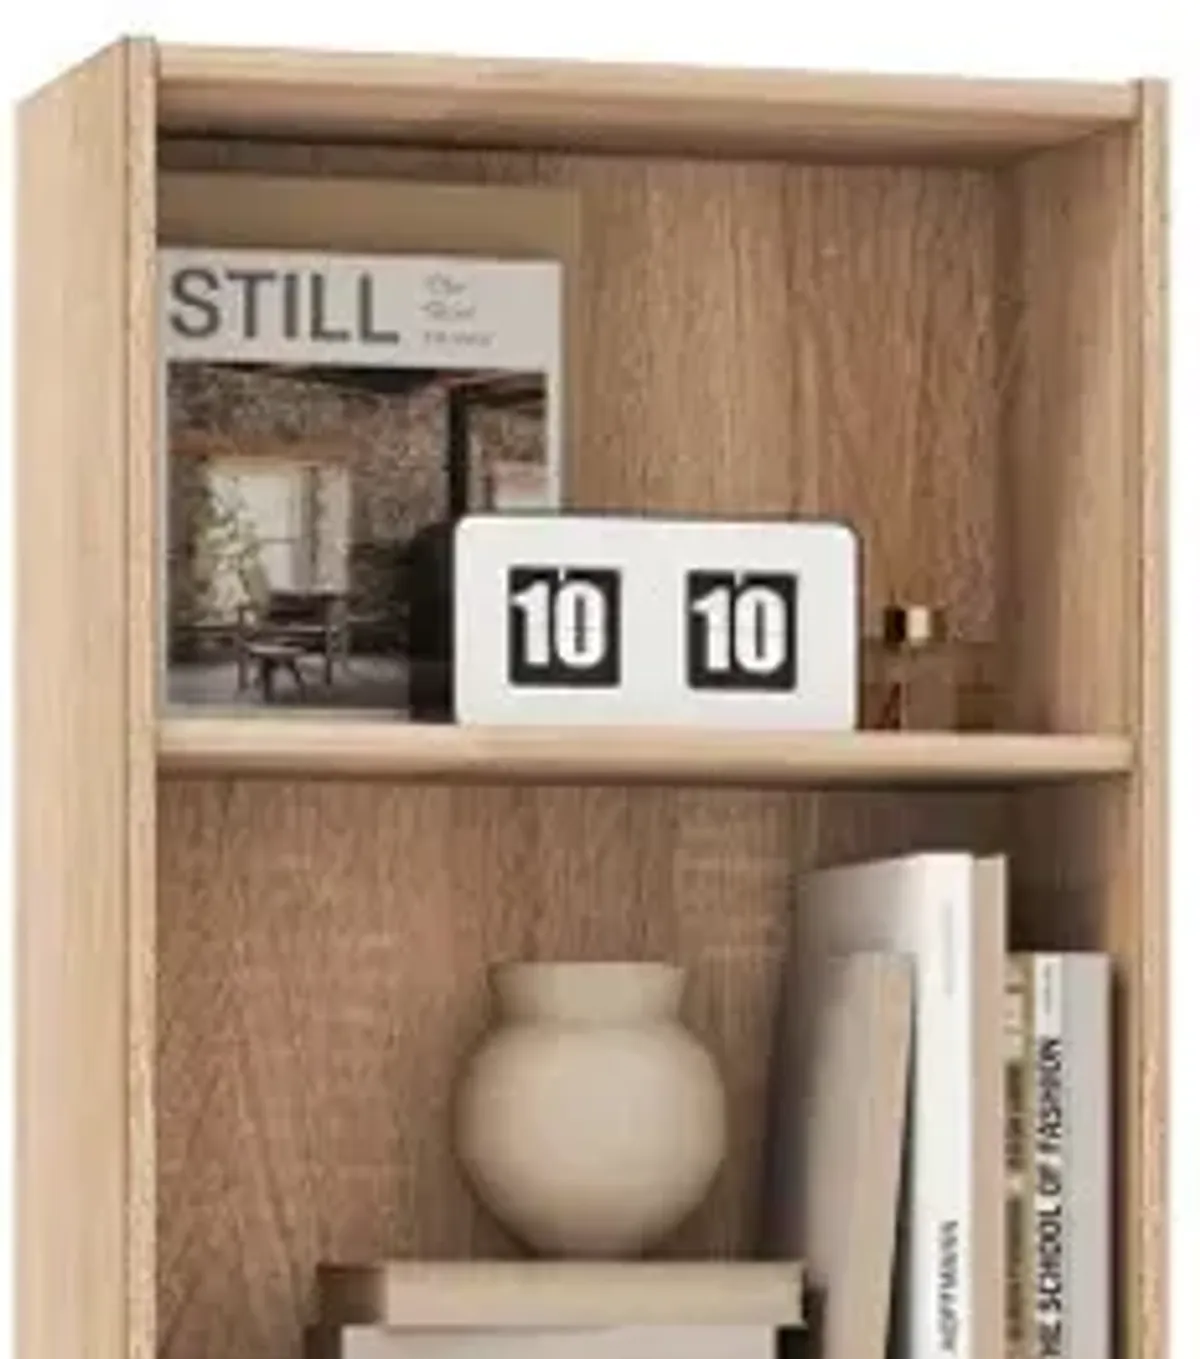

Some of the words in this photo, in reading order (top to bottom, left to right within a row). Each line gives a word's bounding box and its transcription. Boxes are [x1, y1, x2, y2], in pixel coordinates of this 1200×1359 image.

[169, 267, 401, 346] STILL
[511, 579, 607, 668] 10
[692, 586, 787, 673] 10
[1038, 1037, 1063, 1154] FASHION
[1038, 1163, 1063, 1198] OF
[1038, 1204, 1063, 1314] SCHOOL
